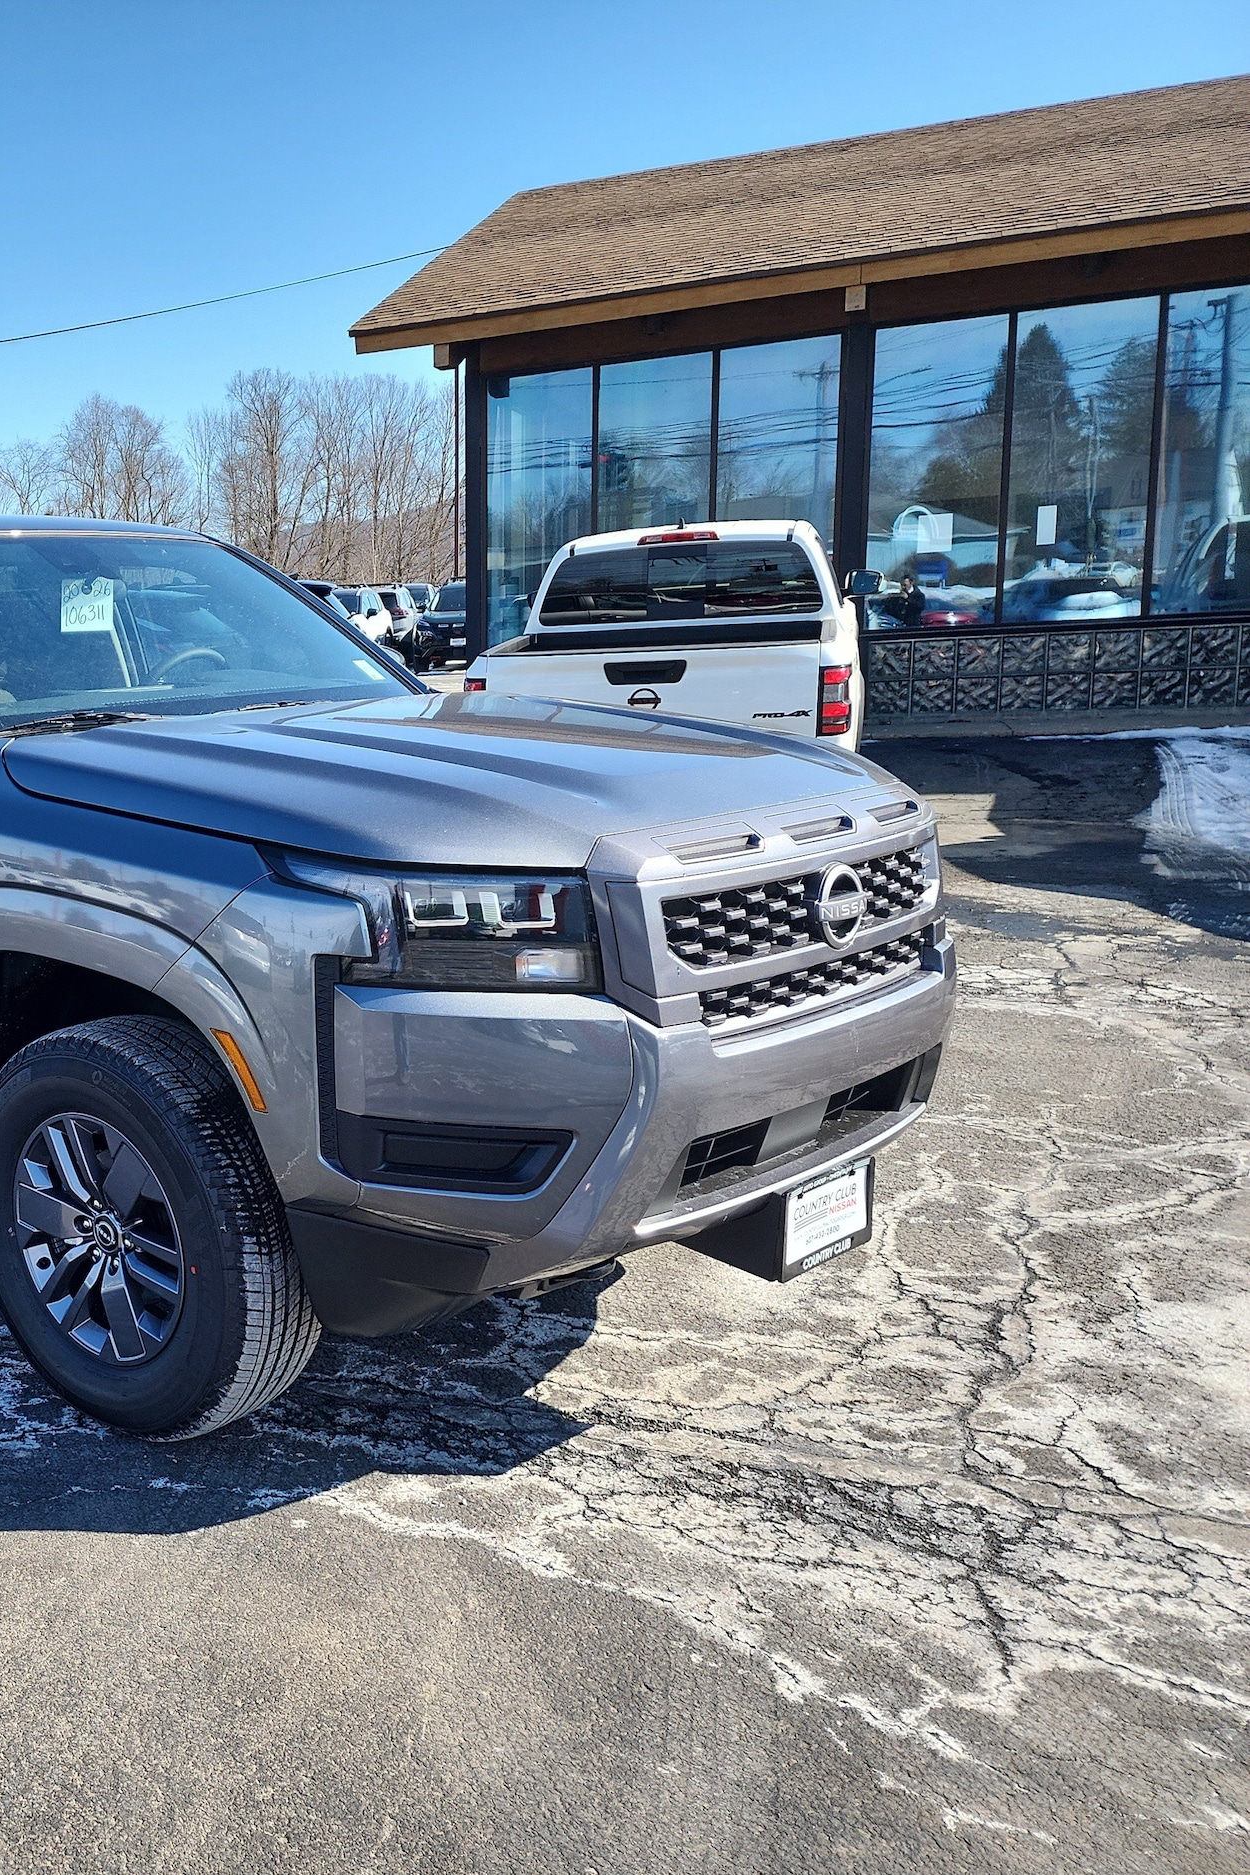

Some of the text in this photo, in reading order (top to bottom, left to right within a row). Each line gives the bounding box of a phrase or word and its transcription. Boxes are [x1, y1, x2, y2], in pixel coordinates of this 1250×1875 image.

[65, 604, 105, 627] 106311
[793, 1183, 857, 1221] COUNTRY CLUB
[829, 1198, 857, 1214] NISSAN
[803, 1238, 852, 1270] COUNTRY CLUB
